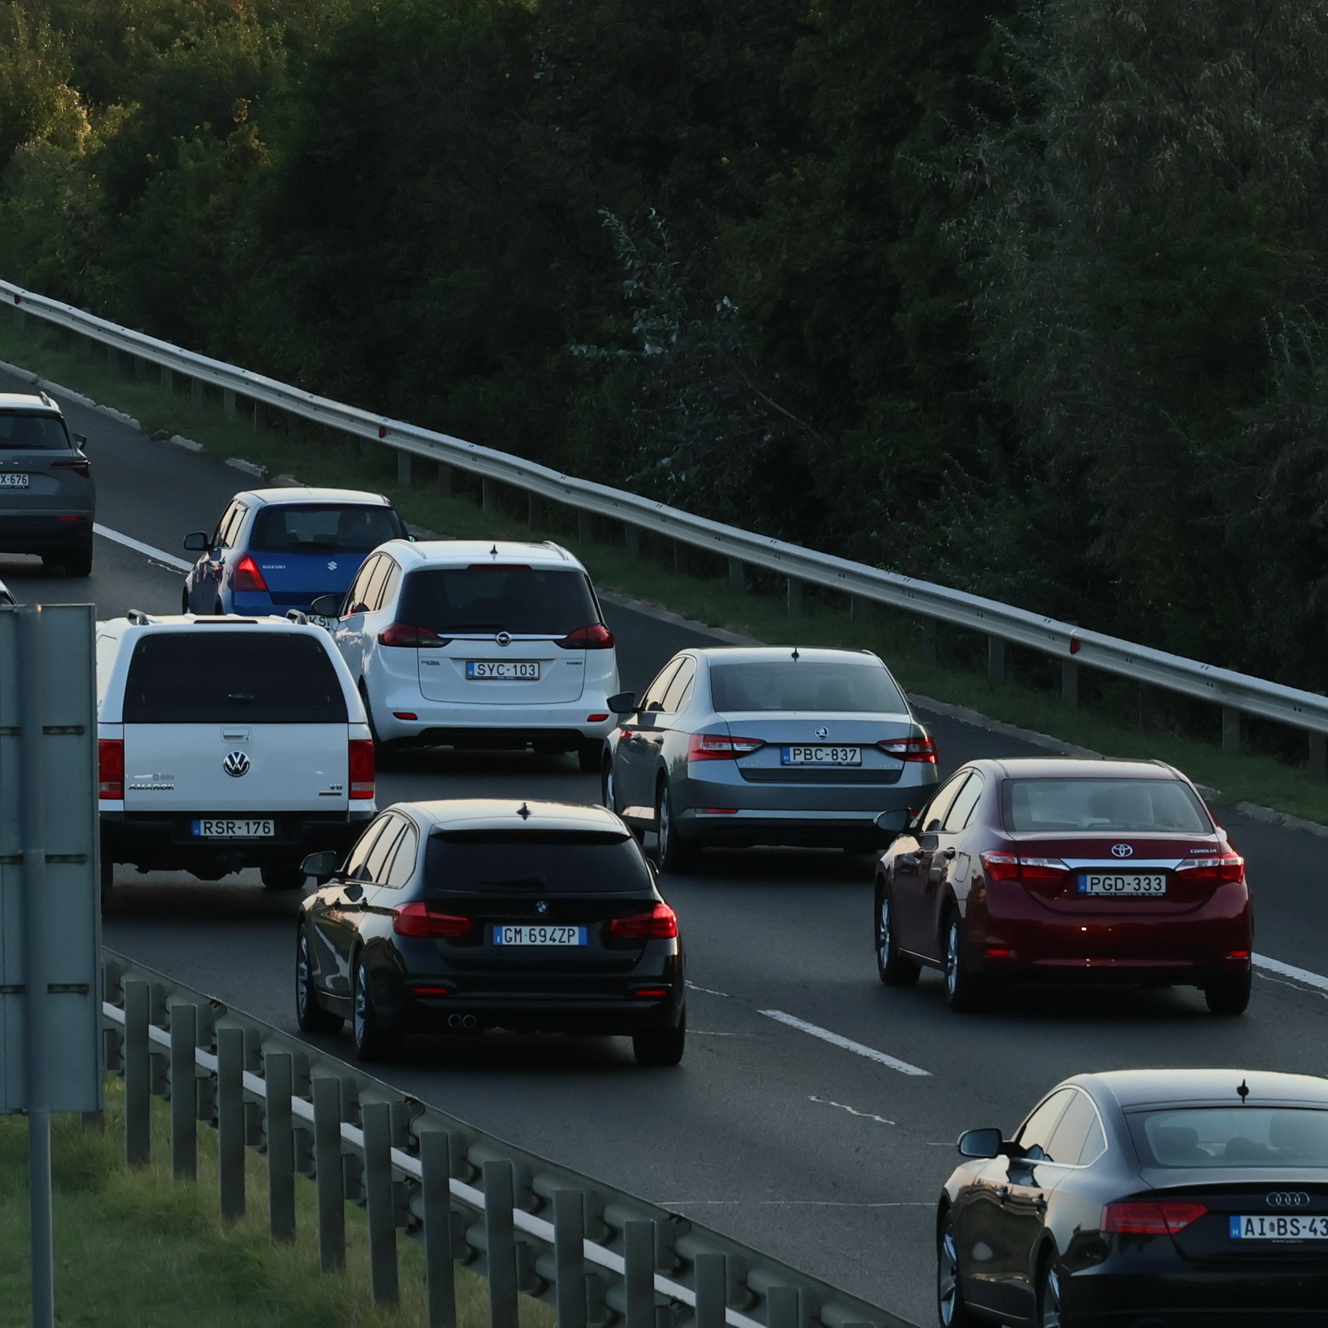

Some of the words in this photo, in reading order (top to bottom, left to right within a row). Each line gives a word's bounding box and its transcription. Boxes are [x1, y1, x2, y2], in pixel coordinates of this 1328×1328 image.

[477, 664, 536, 676] SYC-103
[792, 749, 857, 762] PBC-837
[128, 783, 175, 791] AMAROK
[329, 783, 343, 791] V6
[203, 821, 272, 835] RSR-176
[1090, 877, 1163, 892] PGD-333
